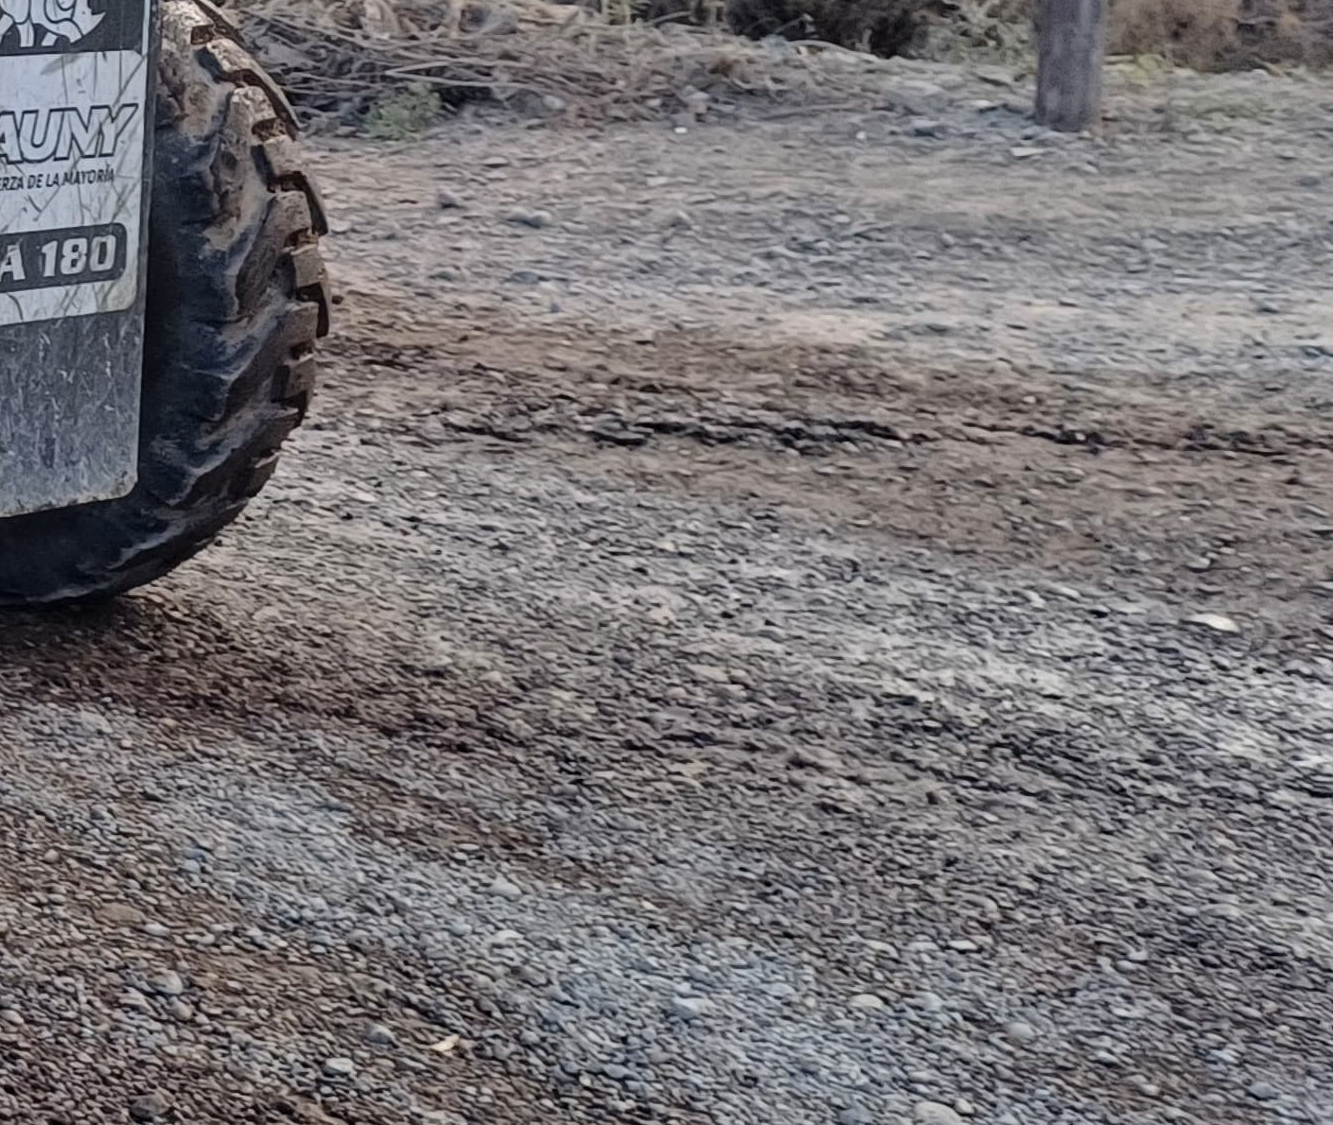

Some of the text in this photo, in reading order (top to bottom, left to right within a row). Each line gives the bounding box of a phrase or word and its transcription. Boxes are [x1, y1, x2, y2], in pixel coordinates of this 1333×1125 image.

[27, 173, 44, 190] DE
[45, 171, 60, 188] LA
[39, 234, 117, 279] 180
